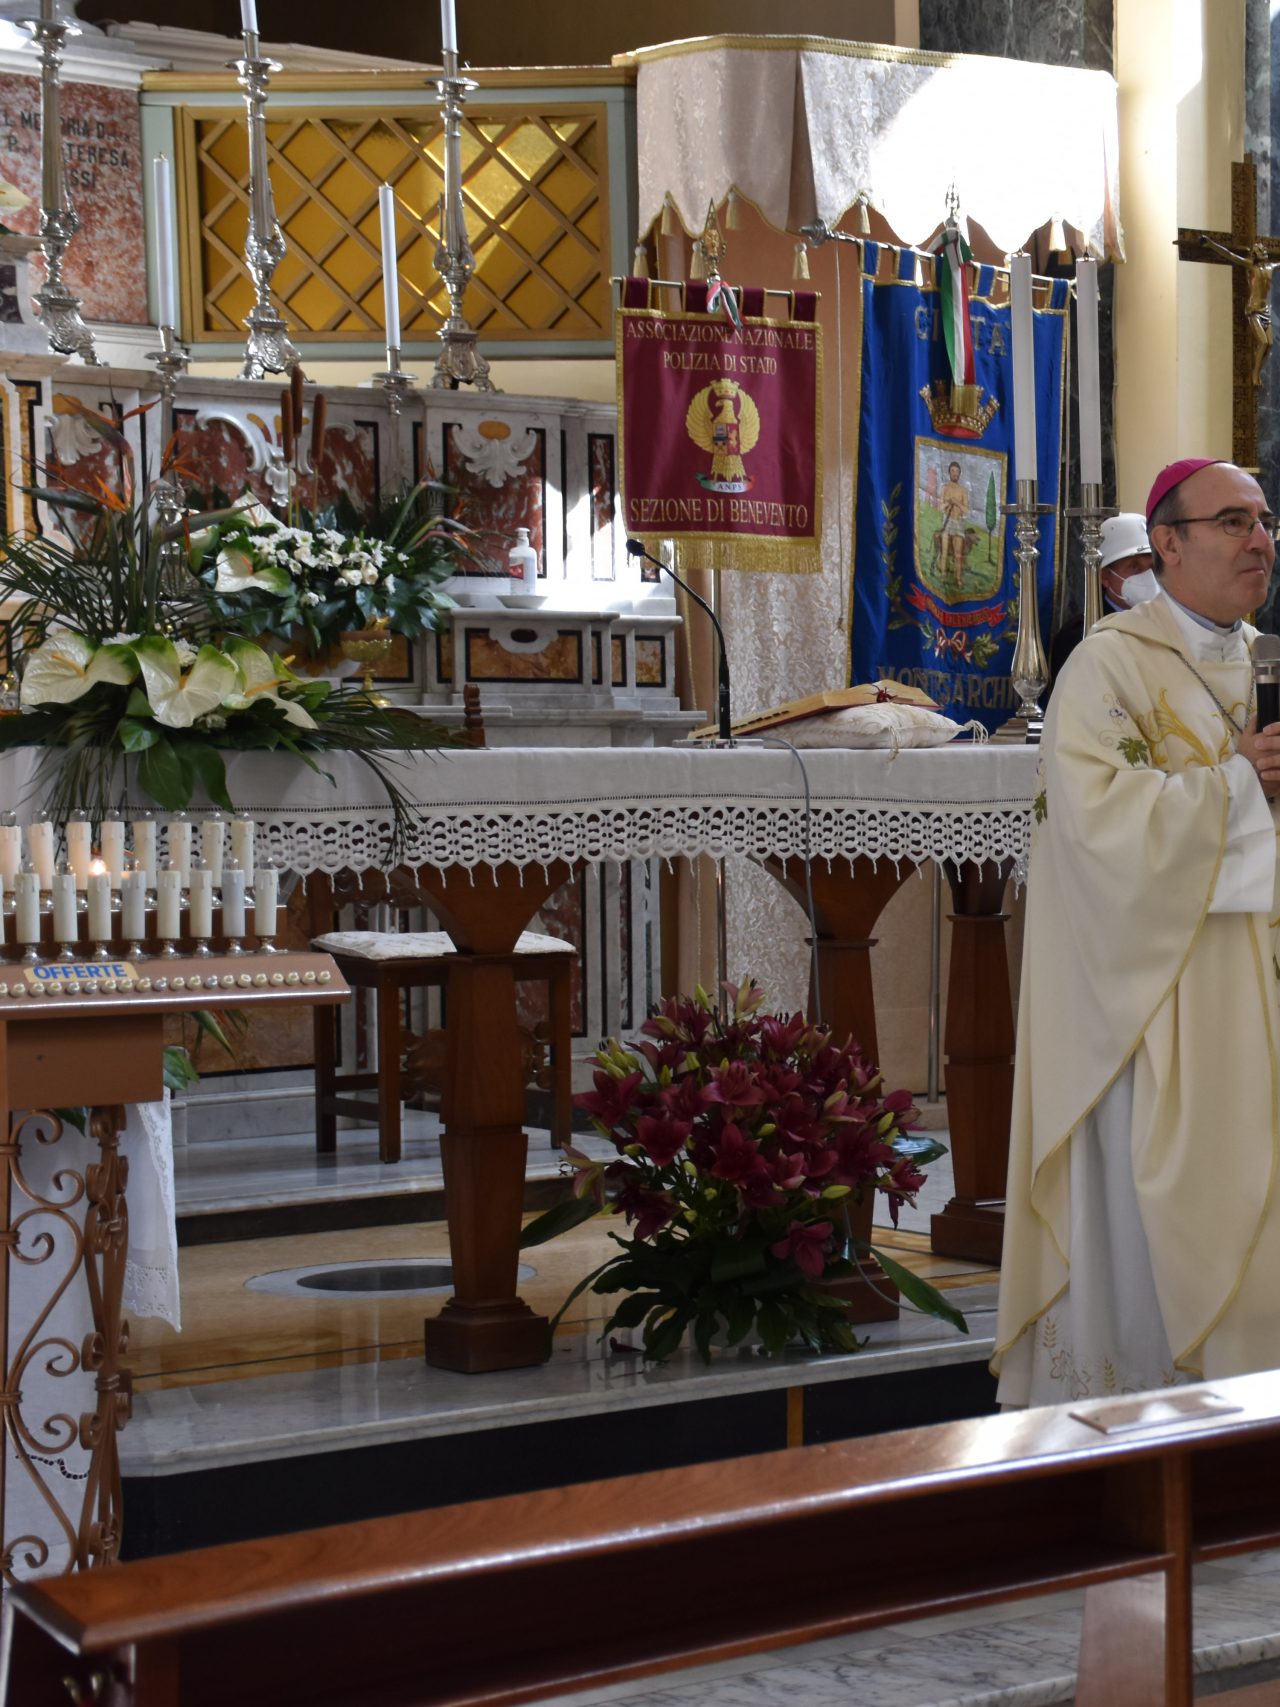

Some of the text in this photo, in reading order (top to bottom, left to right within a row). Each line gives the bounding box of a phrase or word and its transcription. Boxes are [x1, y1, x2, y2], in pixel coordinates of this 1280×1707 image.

[66, 143, 130, 168] TERESA
[626, 321, 814, 350] ASSOCIAZIONE NAZIONALE
[663, 351, 777, 375] POLIZIA DI STATO
[717, 482, 743, 492] ANPS
[630, 498, 808, 529] SEZIONE DI BENEVENTO
[33, 963, 128, 980] OFFERTE
